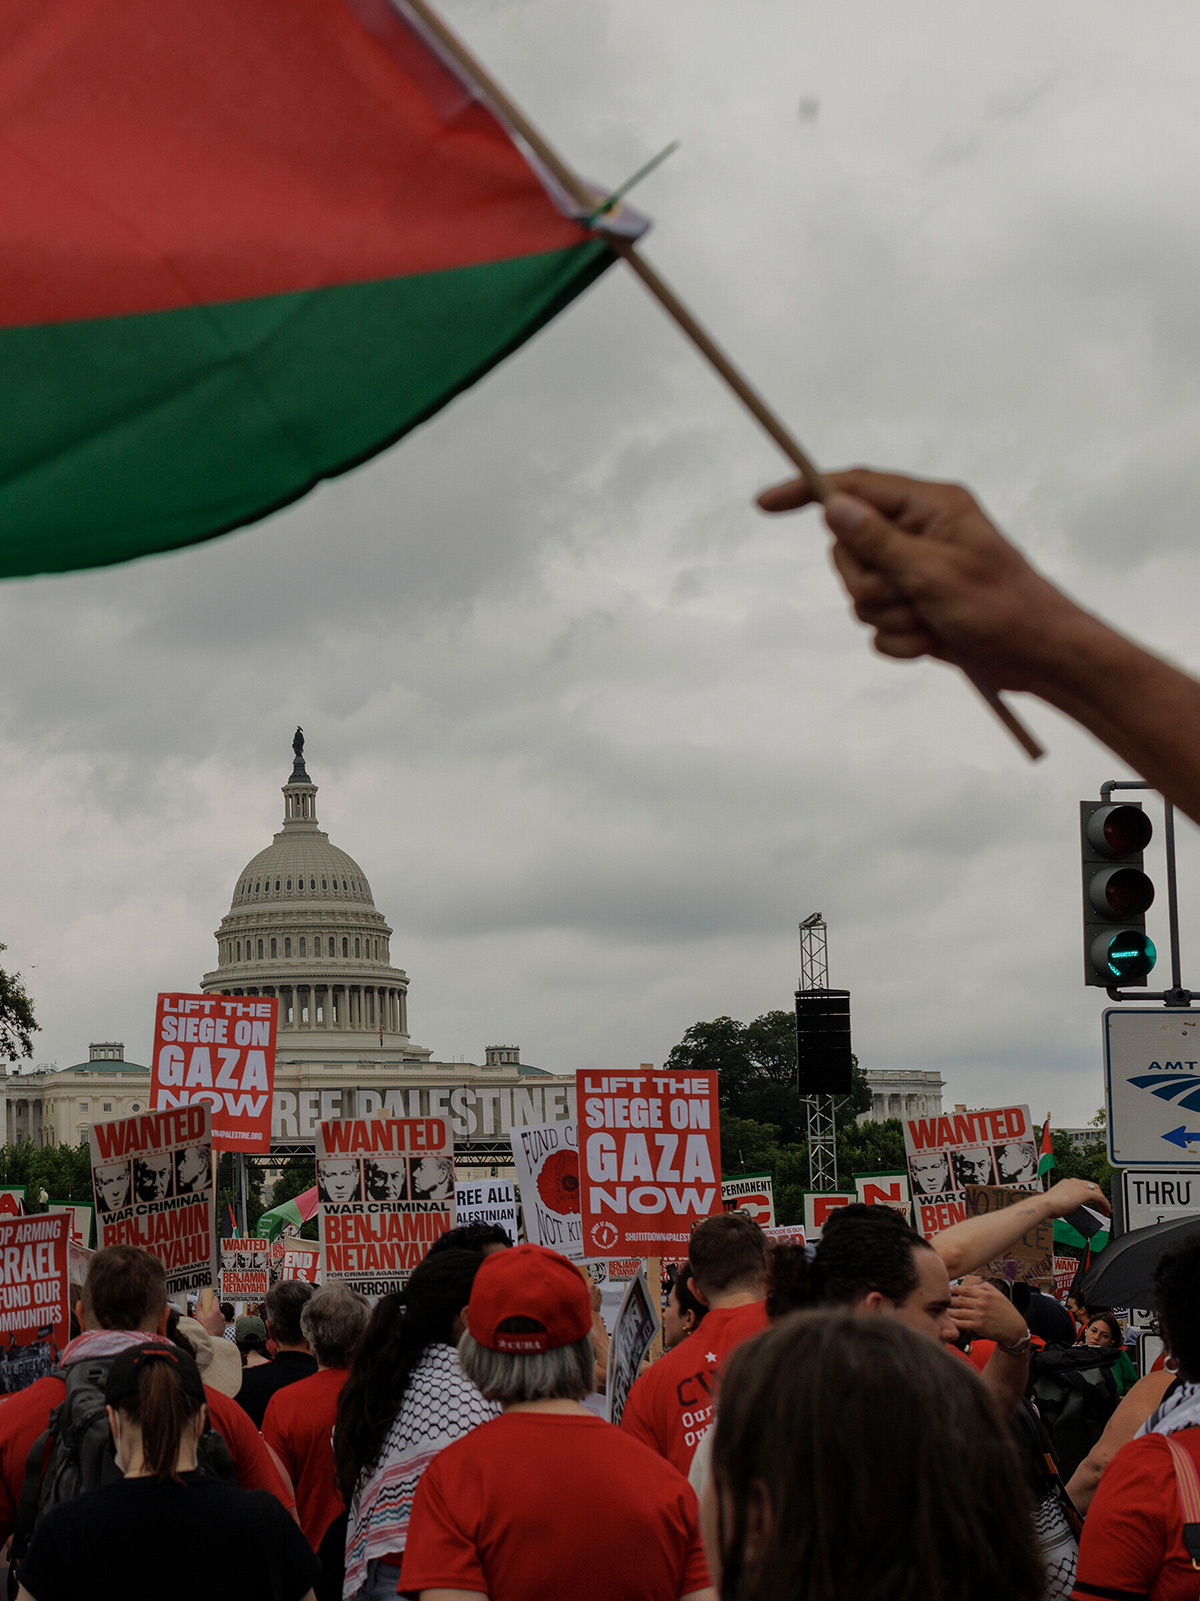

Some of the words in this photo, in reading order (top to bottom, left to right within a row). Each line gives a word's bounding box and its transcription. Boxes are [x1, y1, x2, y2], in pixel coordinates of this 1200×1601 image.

[163, 998, 216, 1014] LIFT
[221, 1001, 272, 1018] THE
[161, 1015, 228, 1044] SIEGE
[234, 1020, 270, 1047] ON
[158, 1045, 269, 1091] GAZA
[1148, 1061, 1198, 1070] AMT
[584, 1077, 646, 1093] LIFT
[652, 1078, 710, 1094] THE
[157, 1089, 269, 1117] NOW
[273, 1090, 342, 1136] REE
[585, 1097, 663, 1128] SIEGE
[669, 1098, 711, 1129] ON
[94, 1106, 205, 1159] WANTED
[321, 1119, 446, 1152] WANTED
[908, 1108, 1026, 1149] WANTED
[520, 1128, 559, 1176] FUND
[586, 1132, 716, 1183] GAZA
[456, 1189, 482, 1206] REE
[488, 1187, 513, 1203] ALL
[589, 1186, 716, 1215] NOW
[722, 1180, 771, 1197] PERMANENT
[918, 1194, 952, 1205] WAR
[1133, 1181, 1190, 1205] THRU
[102, 1210, 133, 1225] WAR
[136, 1192, 208, 1216] CRIMINAL
[324, 1205, 364, 1214] WAR
[368, 1202, 450, 1213] CRIMINAL
[456, 1208, 514, 1223] ALESTINIAN
[15, 1220, 62, 1243] ARMING
[103, 1202, 209, 1249] BENJAMIN
[324, 1212, 450, 1244] BENJAMIN
[535, 1202, 563, 1246] NOT
[223, 1239, 267, 1250] WANTED
[625, 1232, 690, 1242] SHUTITDOWN4PALEST
[284, 1252, 312, 1268] END
[326, 1242, 434, 1271] NETANYA
[1054, 1260, 1079, 1271] WANT
[223, 1272, 267, 1283] BENJAMIN
[223, 1283, 267, 1293] NETANYAHU
[33, 1280, 62, 1304] OUR
[507, 1341, 541, 1350] CUBA
